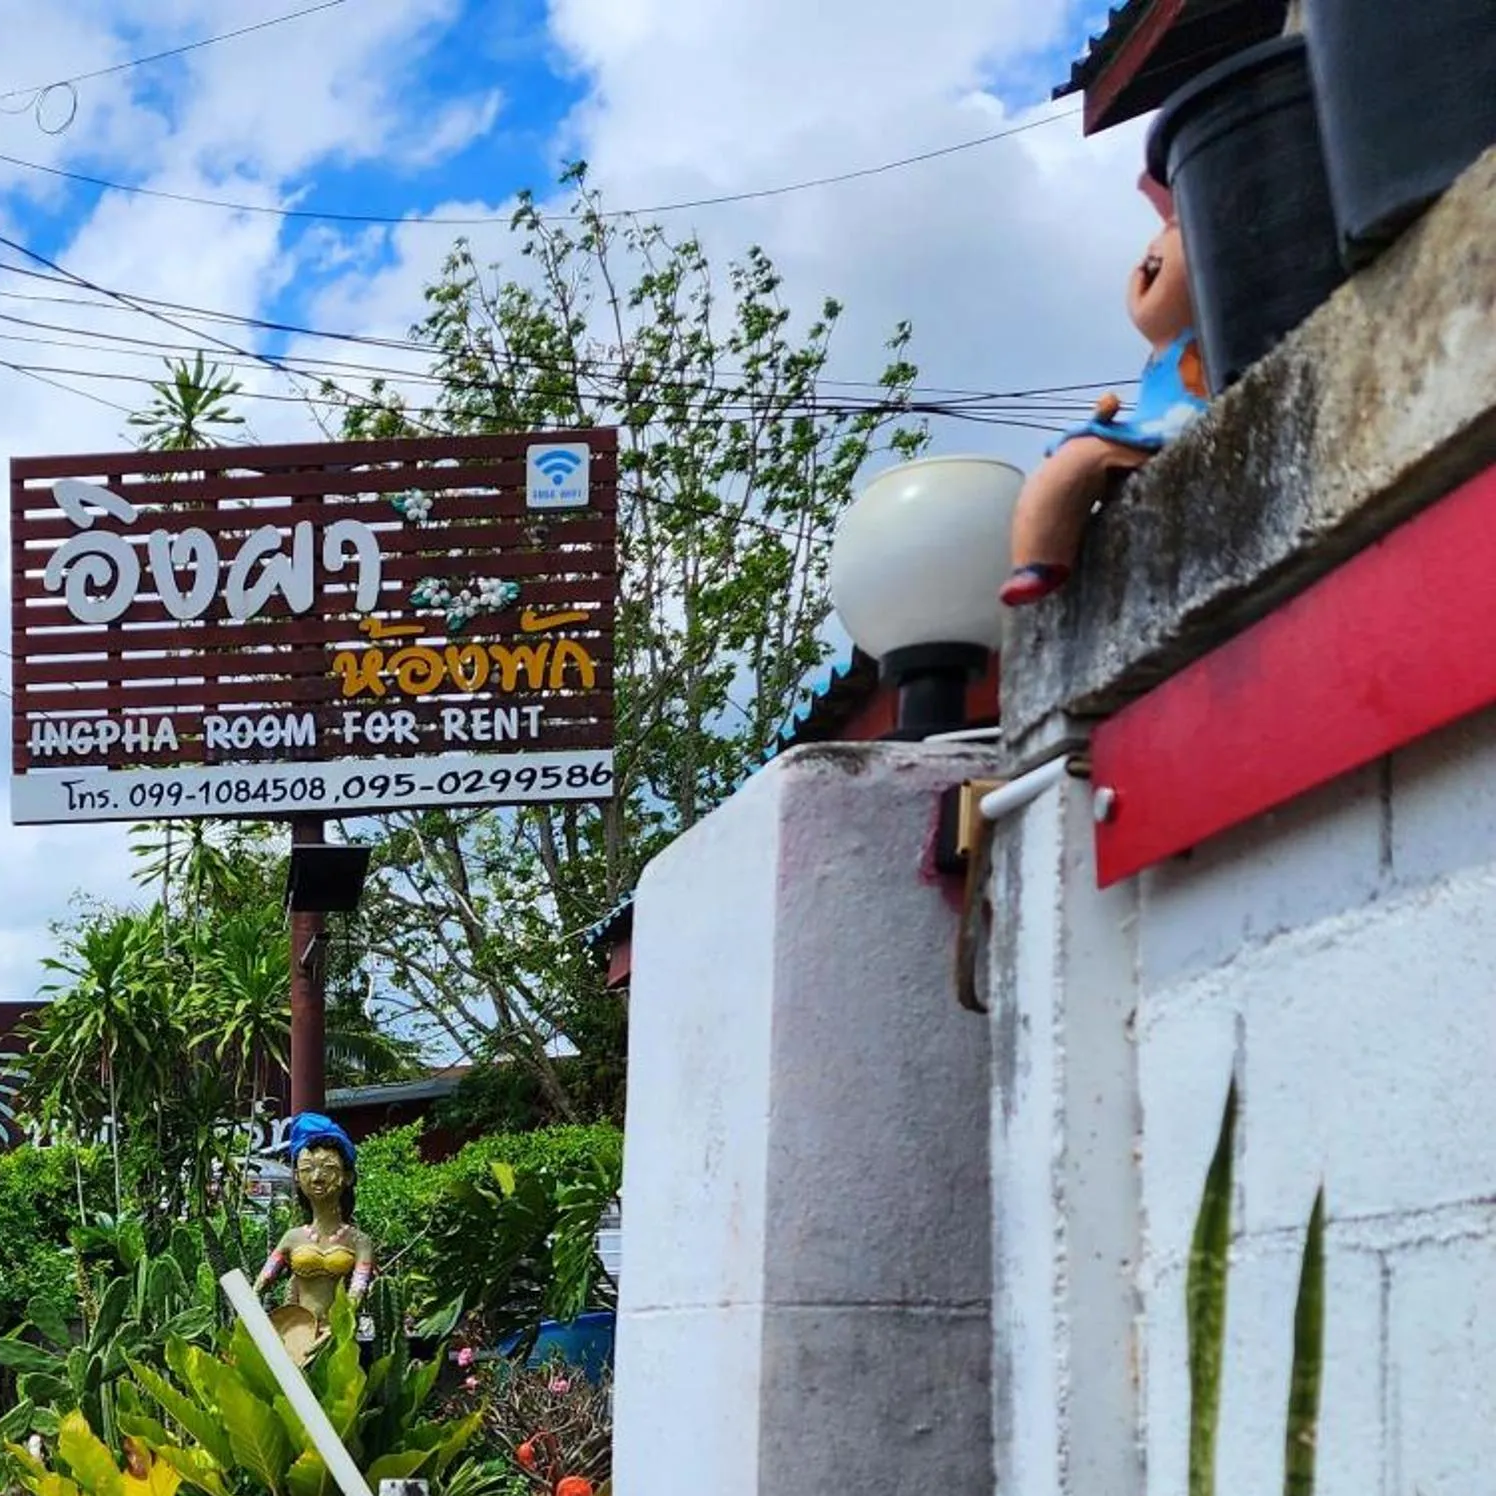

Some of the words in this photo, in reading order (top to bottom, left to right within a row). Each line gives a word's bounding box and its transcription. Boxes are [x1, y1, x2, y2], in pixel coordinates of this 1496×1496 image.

[43, 478, 381, 624] อิงผา
[332, 609, 596, 697] ห้องพัก
[29, 716, 180, 757] INGPHA
[202, 712, 317, 750] ROOM
[342, 708, 420, 745] FOR
[440, 704, 545, 743] RENT
[60, 778, 119, 811] โทร.
[128, 776, 326, 807] 099-1084508
